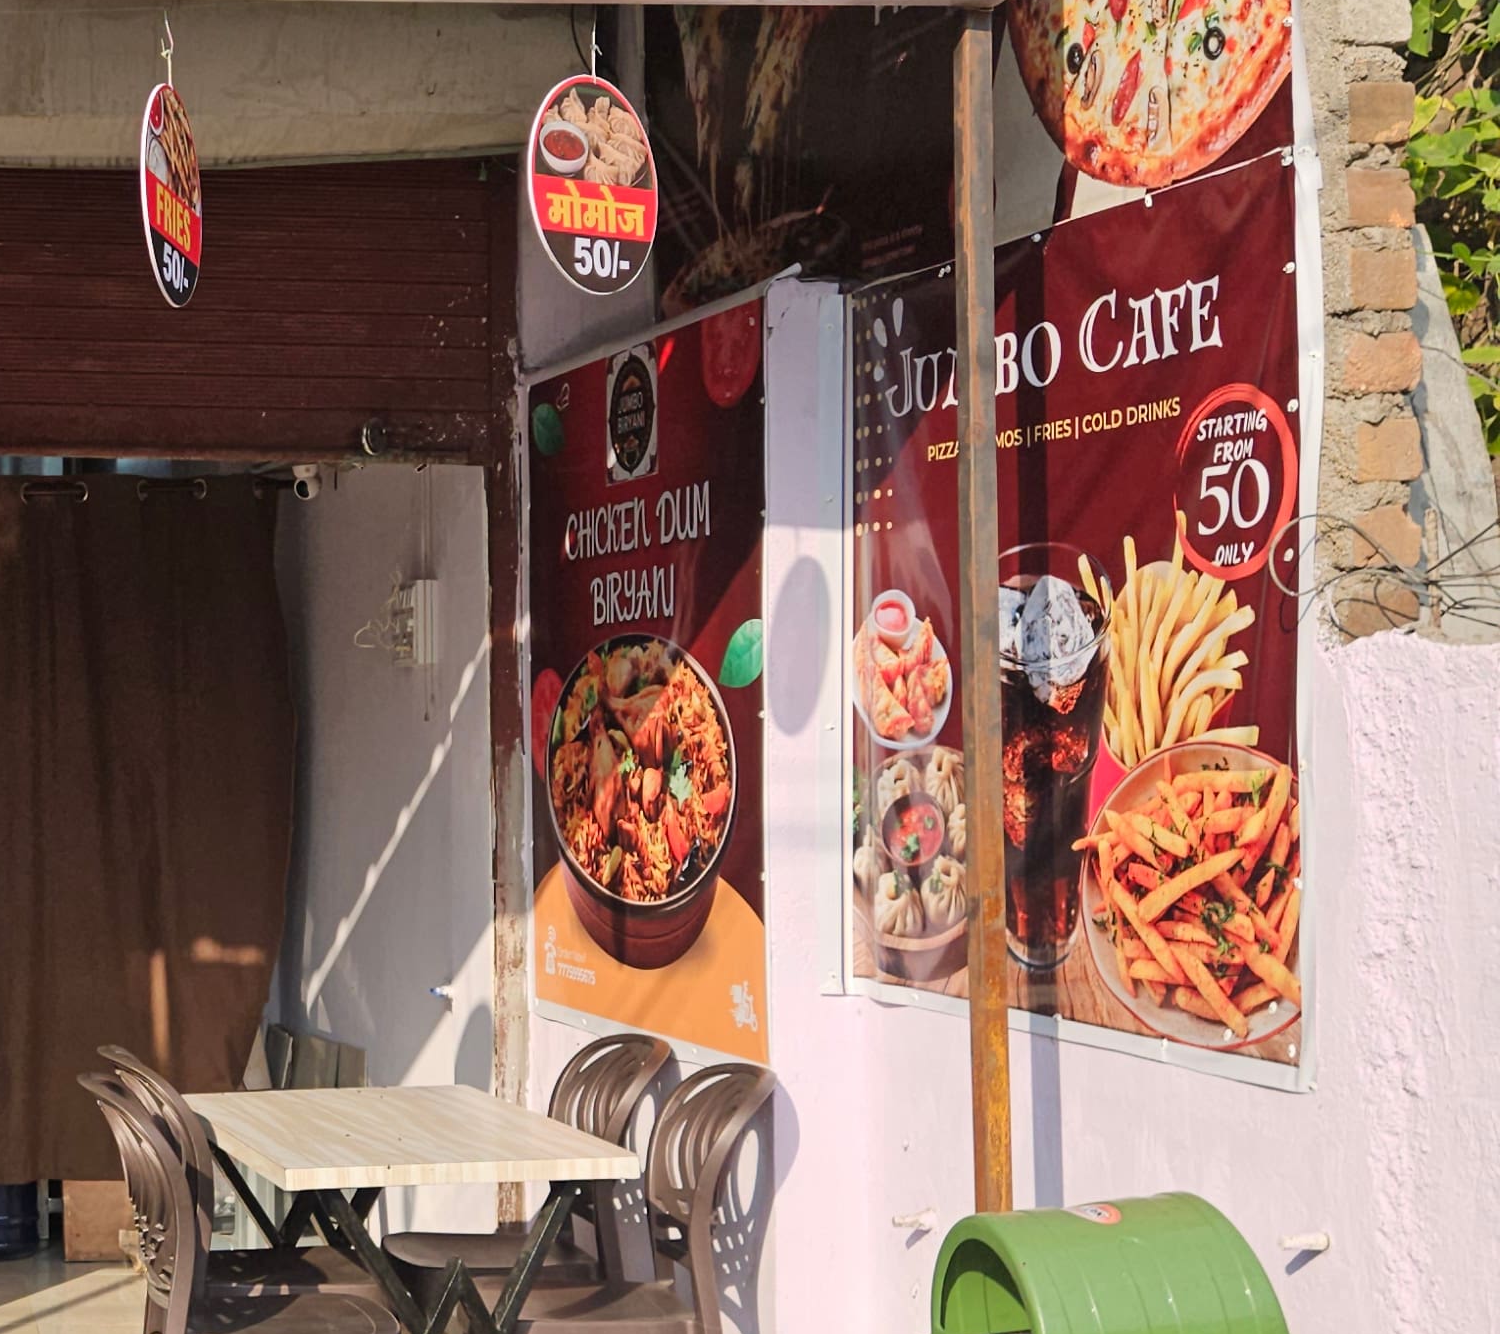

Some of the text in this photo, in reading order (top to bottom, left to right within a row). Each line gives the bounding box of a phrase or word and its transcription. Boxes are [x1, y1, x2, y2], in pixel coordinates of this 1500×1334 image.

[155, 182, 191, 253] FRIES
[546, 180, 646, 237] मोमोज
[162, 242, 189, 293] 50/-
[573, 236, 630, 279] 50/-
[1078, 275, 1224, 373] CAFE
[1034, 418, 1072, 443] FRIES
[1082, 409, 1123, 434] COLD
[1126, 397, 1181, 426] DRINKS
[1196, 407, 1268, 442] STARTING
[1213, 437, 1254, 464] FROM
[564, 480, 711, 561] CHICKEN DUM
[1197, 458, 1271, 536] 50
[1213, 541, 1255, 567] ONLY
[590, 563, 675, 626] BIRYANI
